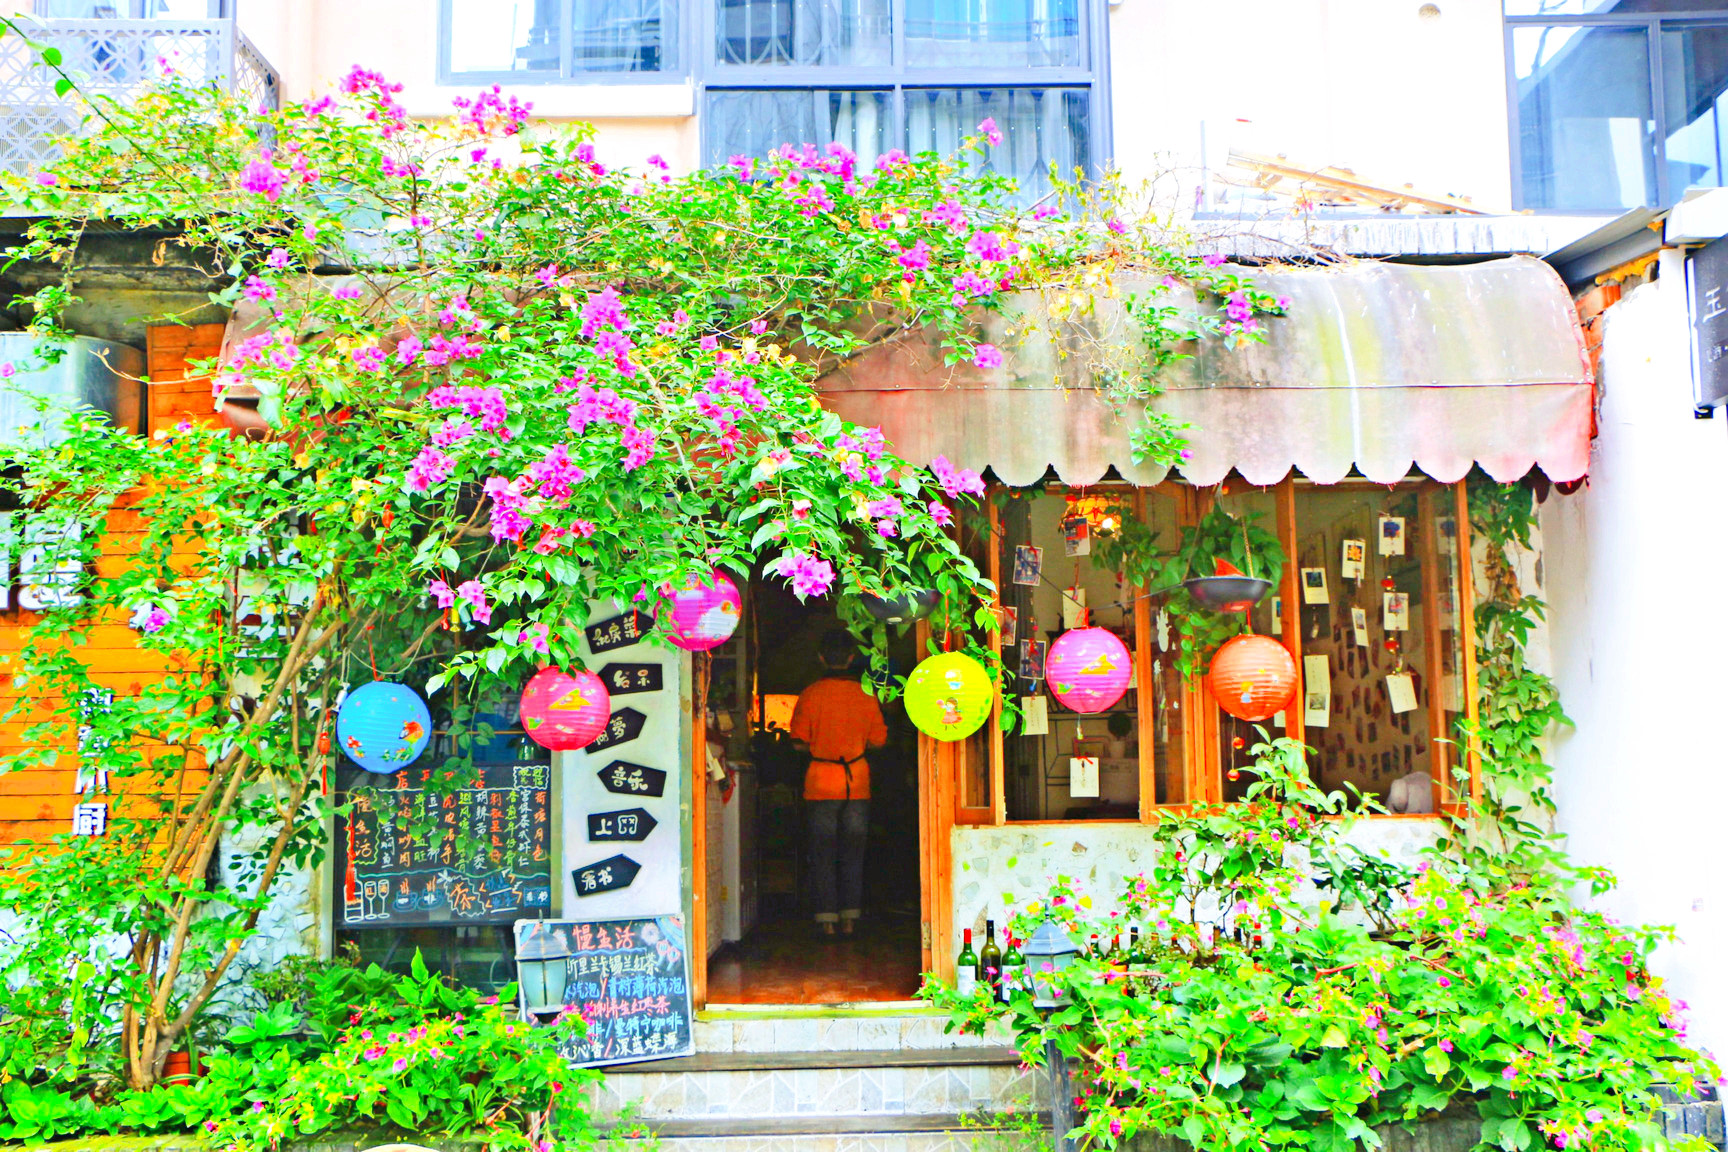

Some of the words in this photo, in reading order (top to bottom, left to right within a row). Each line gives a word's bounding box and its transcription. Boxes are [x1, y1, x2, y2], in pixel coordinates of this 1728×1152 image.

[611, 765, 648, 791] 音乐
[595, 814, 638, 836] 上网
[581, 866, 613, 891] 看书
[450, 882, 476, 910] 茶
[572, 923, 636, 950] 慢生活
